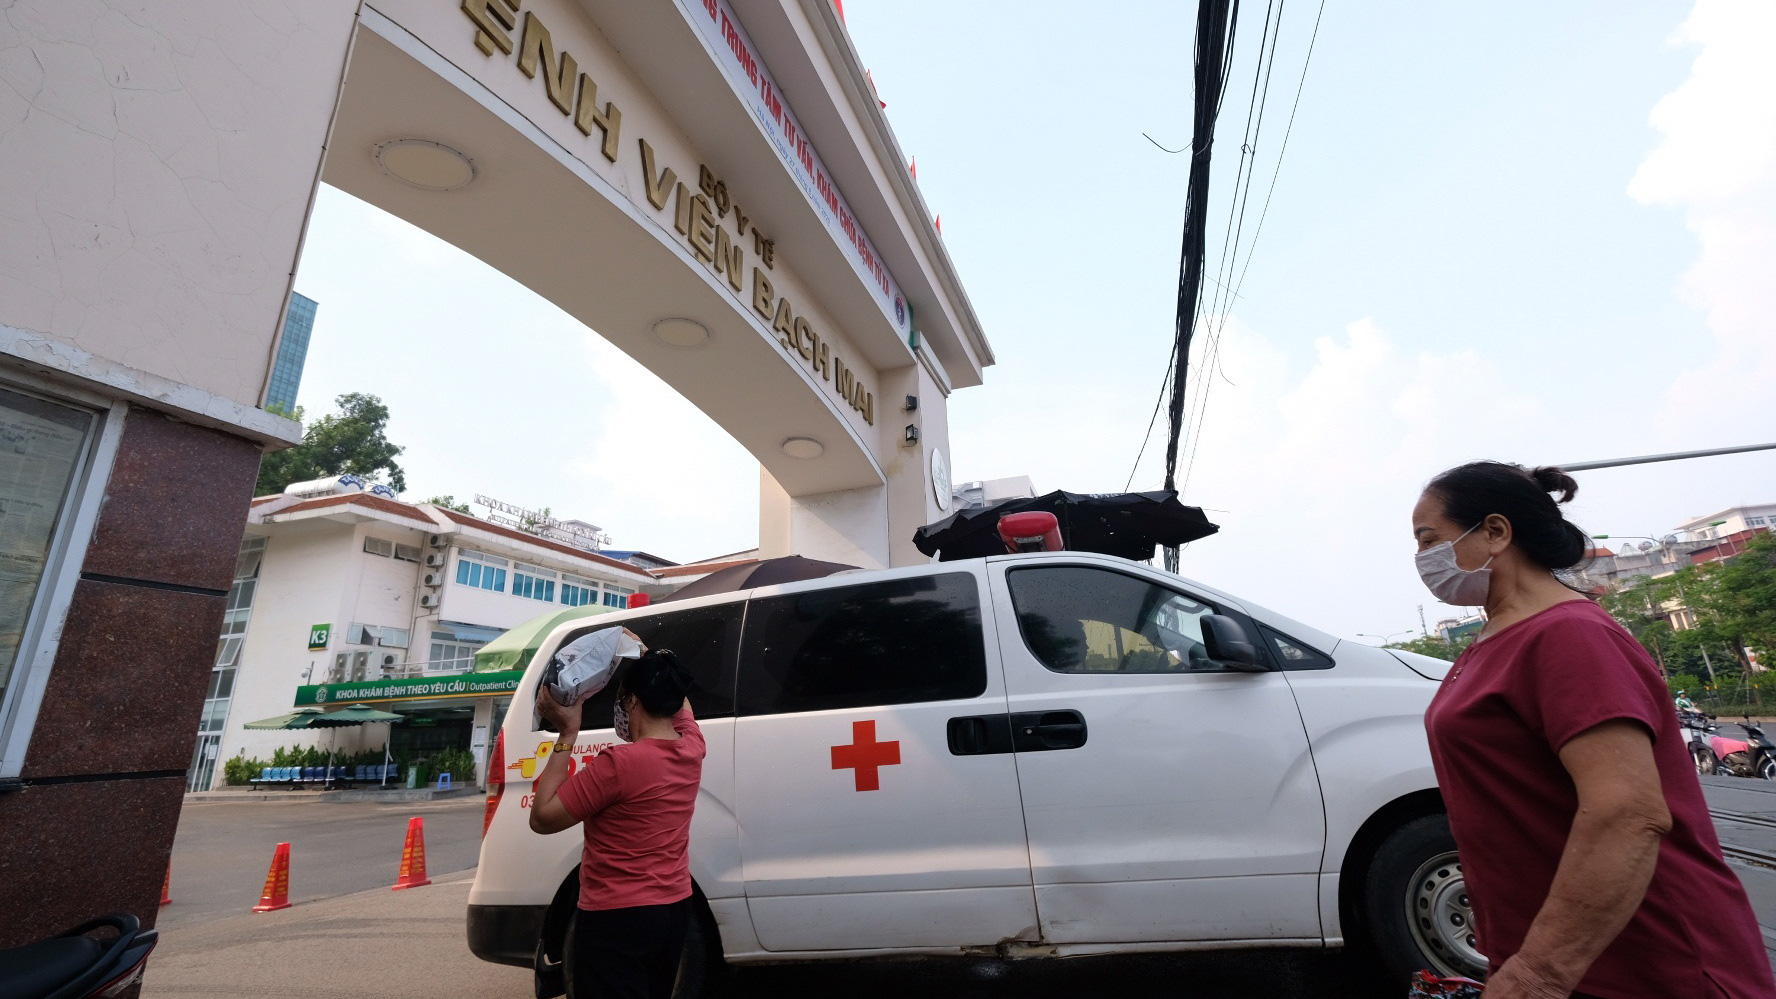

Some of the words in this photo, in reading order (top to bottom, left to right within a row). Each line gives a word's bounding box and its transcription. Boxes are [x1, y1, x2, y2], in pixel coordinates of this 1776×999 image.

[720, 7, 758, 90] TRUNG
[760, 73, 782, 127] TÂM
[816, 168, 839, 220] KHÁM
[699, 163, 731, 219] BỘ
[733, 205, 750, 236] Y
[751, 227, 775, 271] TẾ
[638, 138, 744, 292] VIỆN
[753, 266, 830, 381] BẠCH
[835, 356, 874, 427] MAI
[310, 630, 328, 644] K3
[335, 690, 358, 699] KHOA
[359, 687, 383, 698] KHÁM
[384, 685, 406, 698] BỆNH
[407, 684, 429, 695] THEO
[430, 682, 447, 694] YÊU
[447, 680, 466, 692] CẦU
[469, 682, 506, 692] Outpatient
